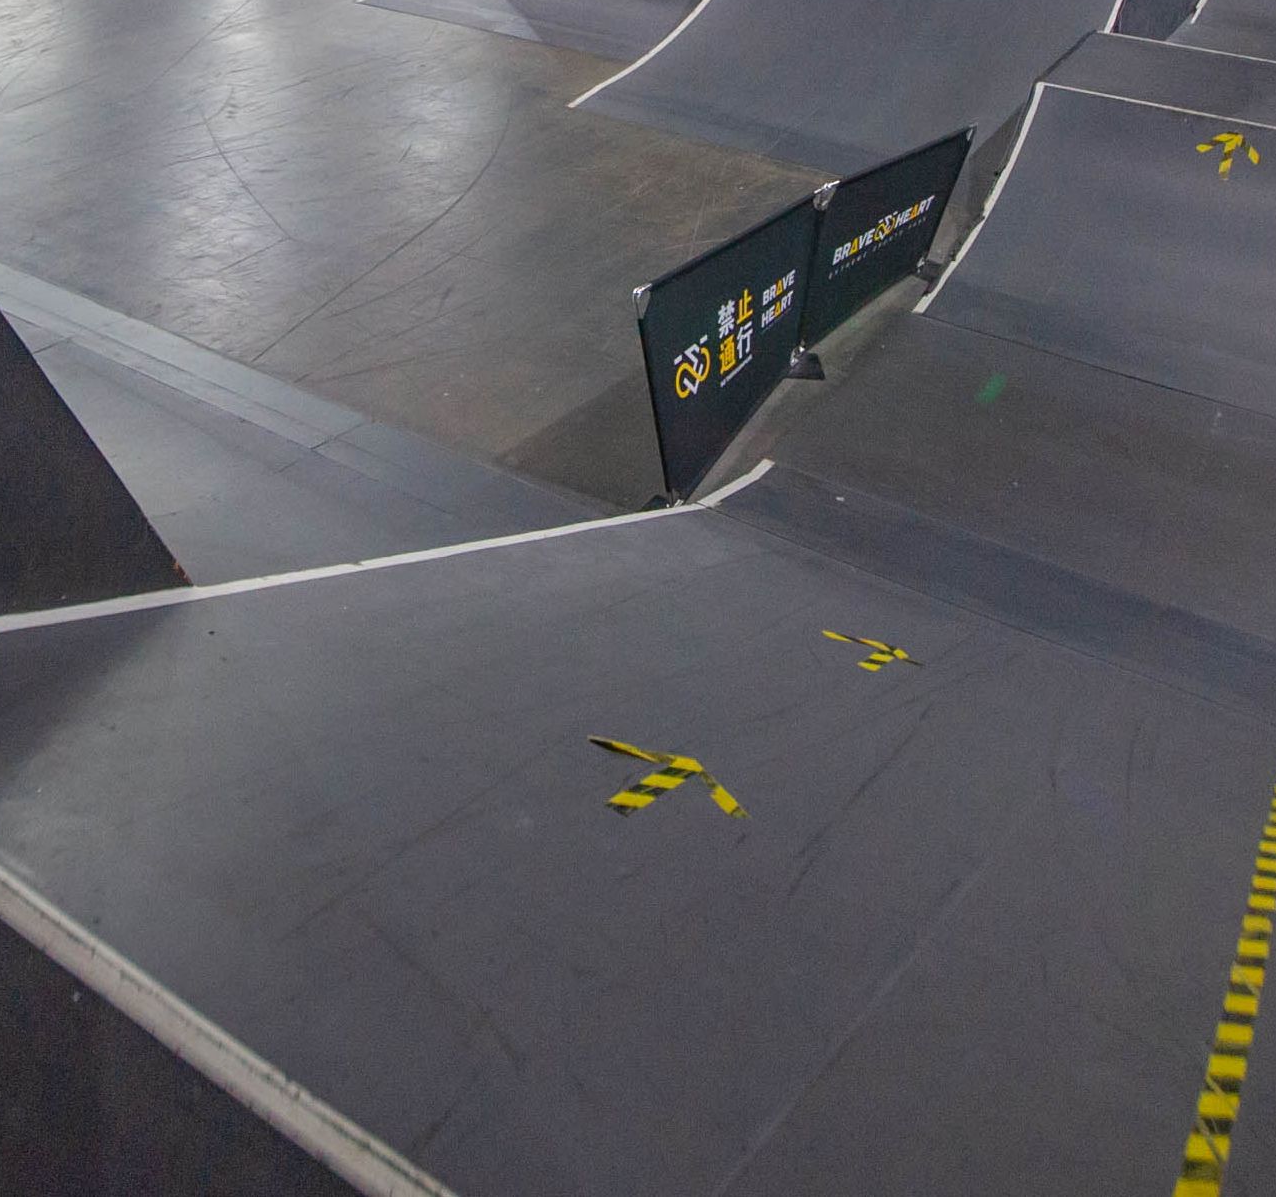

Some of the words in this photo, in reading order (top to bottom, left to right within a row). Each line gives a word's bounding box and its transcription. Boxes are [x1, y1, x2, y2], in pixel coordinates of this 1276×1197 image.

[832, 228, 876, 266] BRAVE
[894, 195, 935, 229] HEART
[761, 290, 794, 328] HEART
[762, 269, 796, 306] BRAVE
[718, 288, 753, 339] 禁止
[719, 321, 753, 374] 通行
